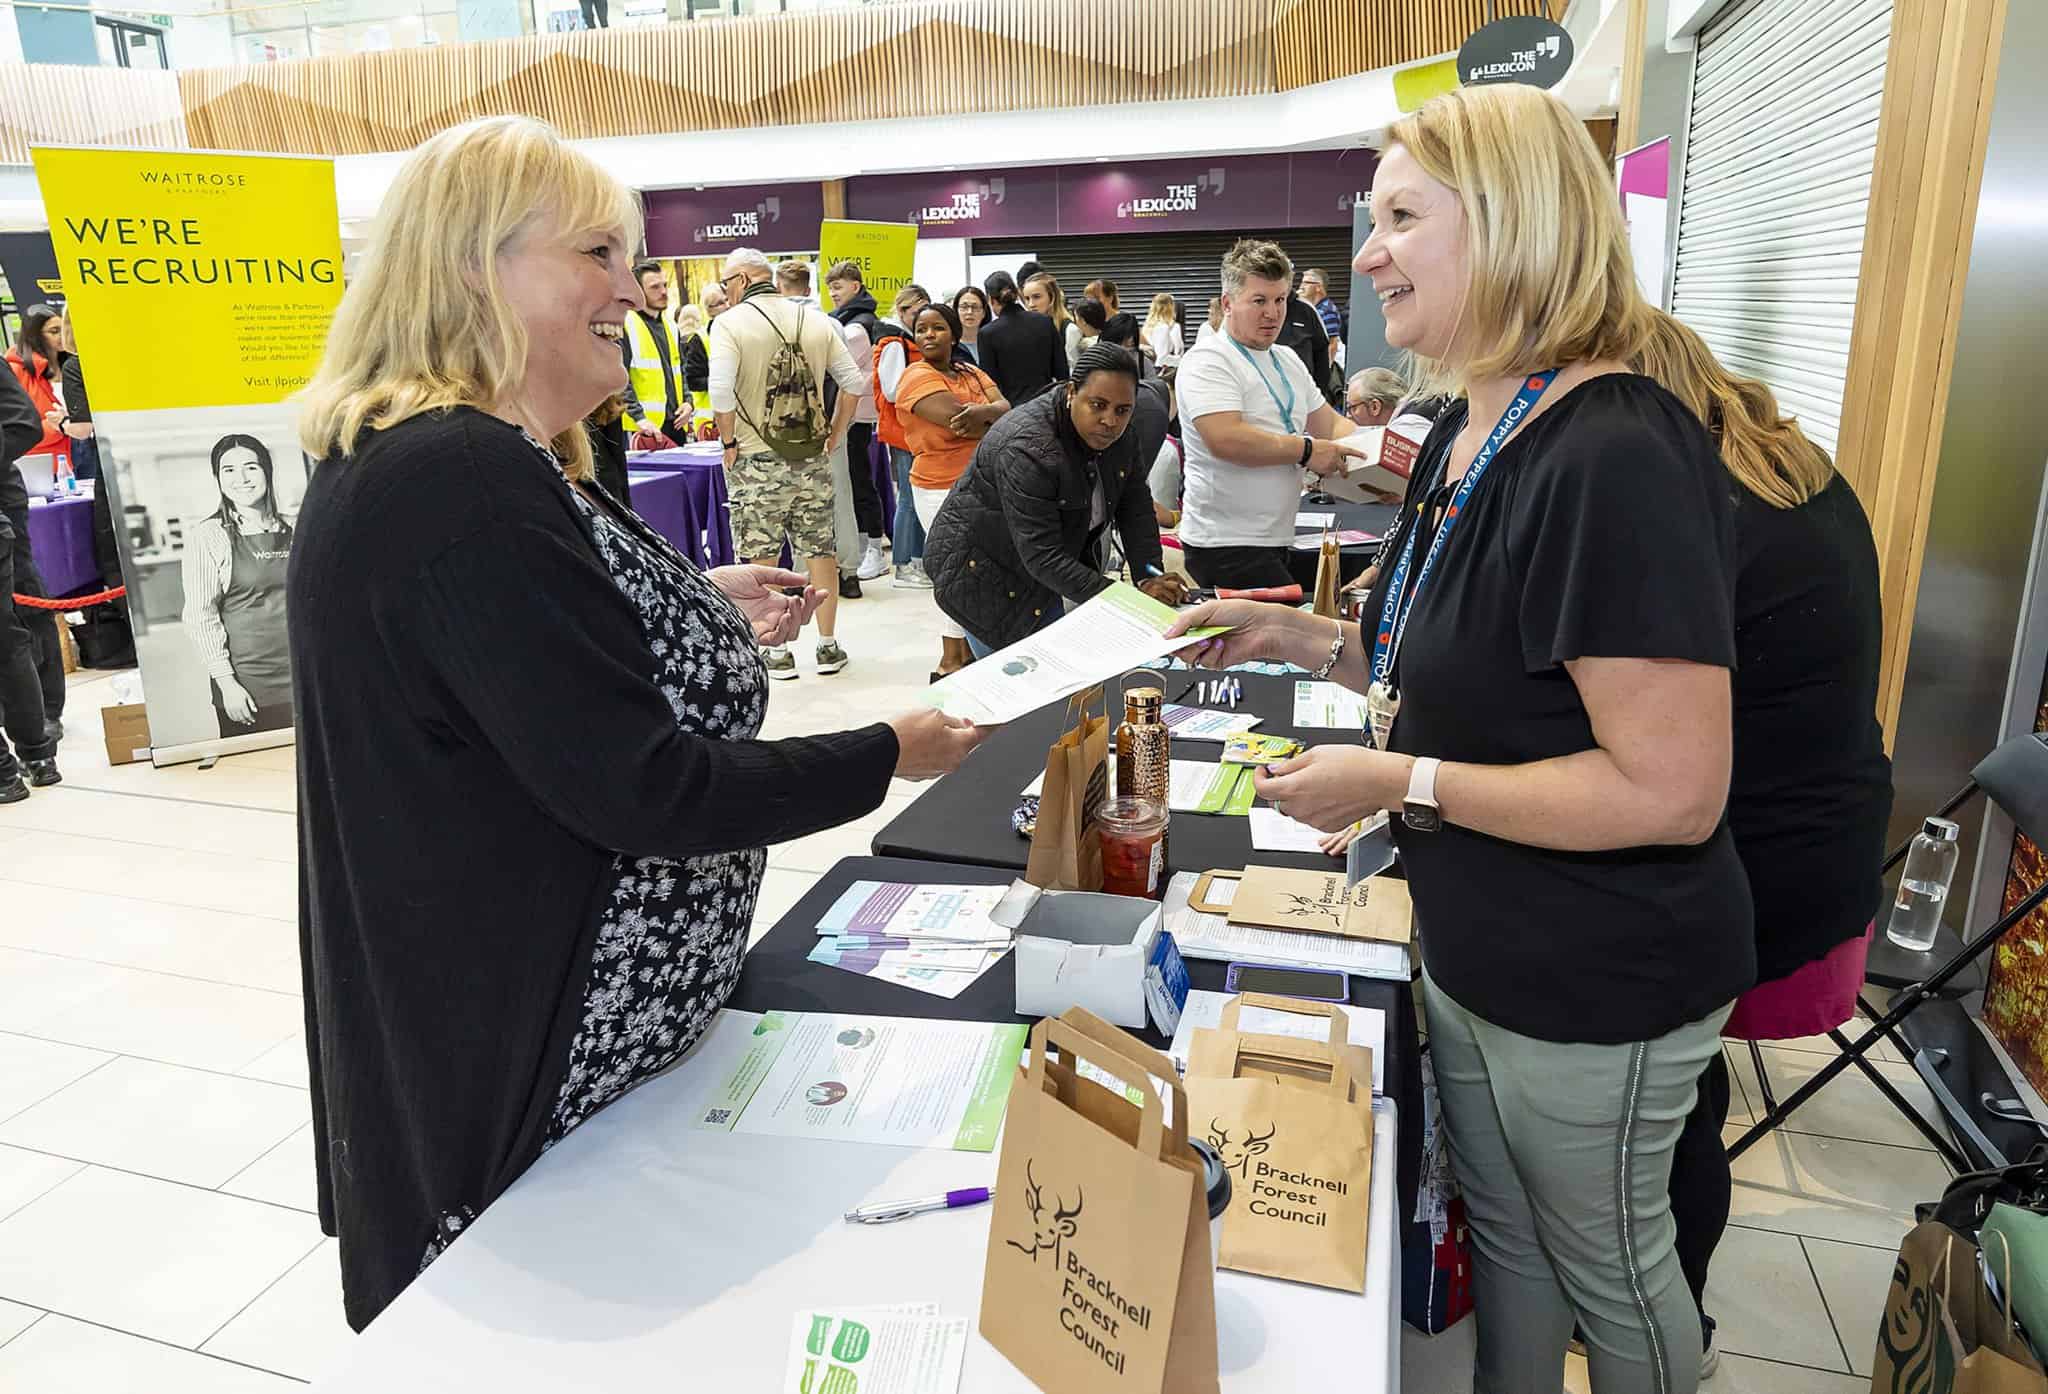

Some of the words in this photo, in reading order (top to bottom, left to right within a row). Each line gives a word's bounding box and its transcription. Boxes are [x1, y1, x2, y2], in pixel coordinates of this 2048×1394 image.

[1511, 50, 1537, 62] THE
[1484, 61, 1536, 75] LEXICON
[140, 171, 246, 186] WAITROSE
[951, 193, 980, 207] THE
[1166, 184, 1197, 198] THE
[922, 206, 980, 220] LEXICON
[1133, 198, 1197, 212] LEXICON
[732, 212, 758, 224] THE
[706, 224, 759, 237] LEXICON
[78, 258, 335, 285] RECRUITING
[244, 376, 271, 387] Visit
[1492, 398, 1529, 445] POPPY
[1459, 445, 1492, 495] APPEAL
[1384, 577, 1401, 623] POPPY
[1256, 1162, 1348, 1196] Bracknell
[1252, 1180, 1318, 1206] Forest
[1249, 1200, 1327, 1227] Council
[1066, 1250, 1152, 1330] Bracknell
[1062, 1278, 1120, 1339] Forest
[1059, 1307, 1126, 1375] Council
